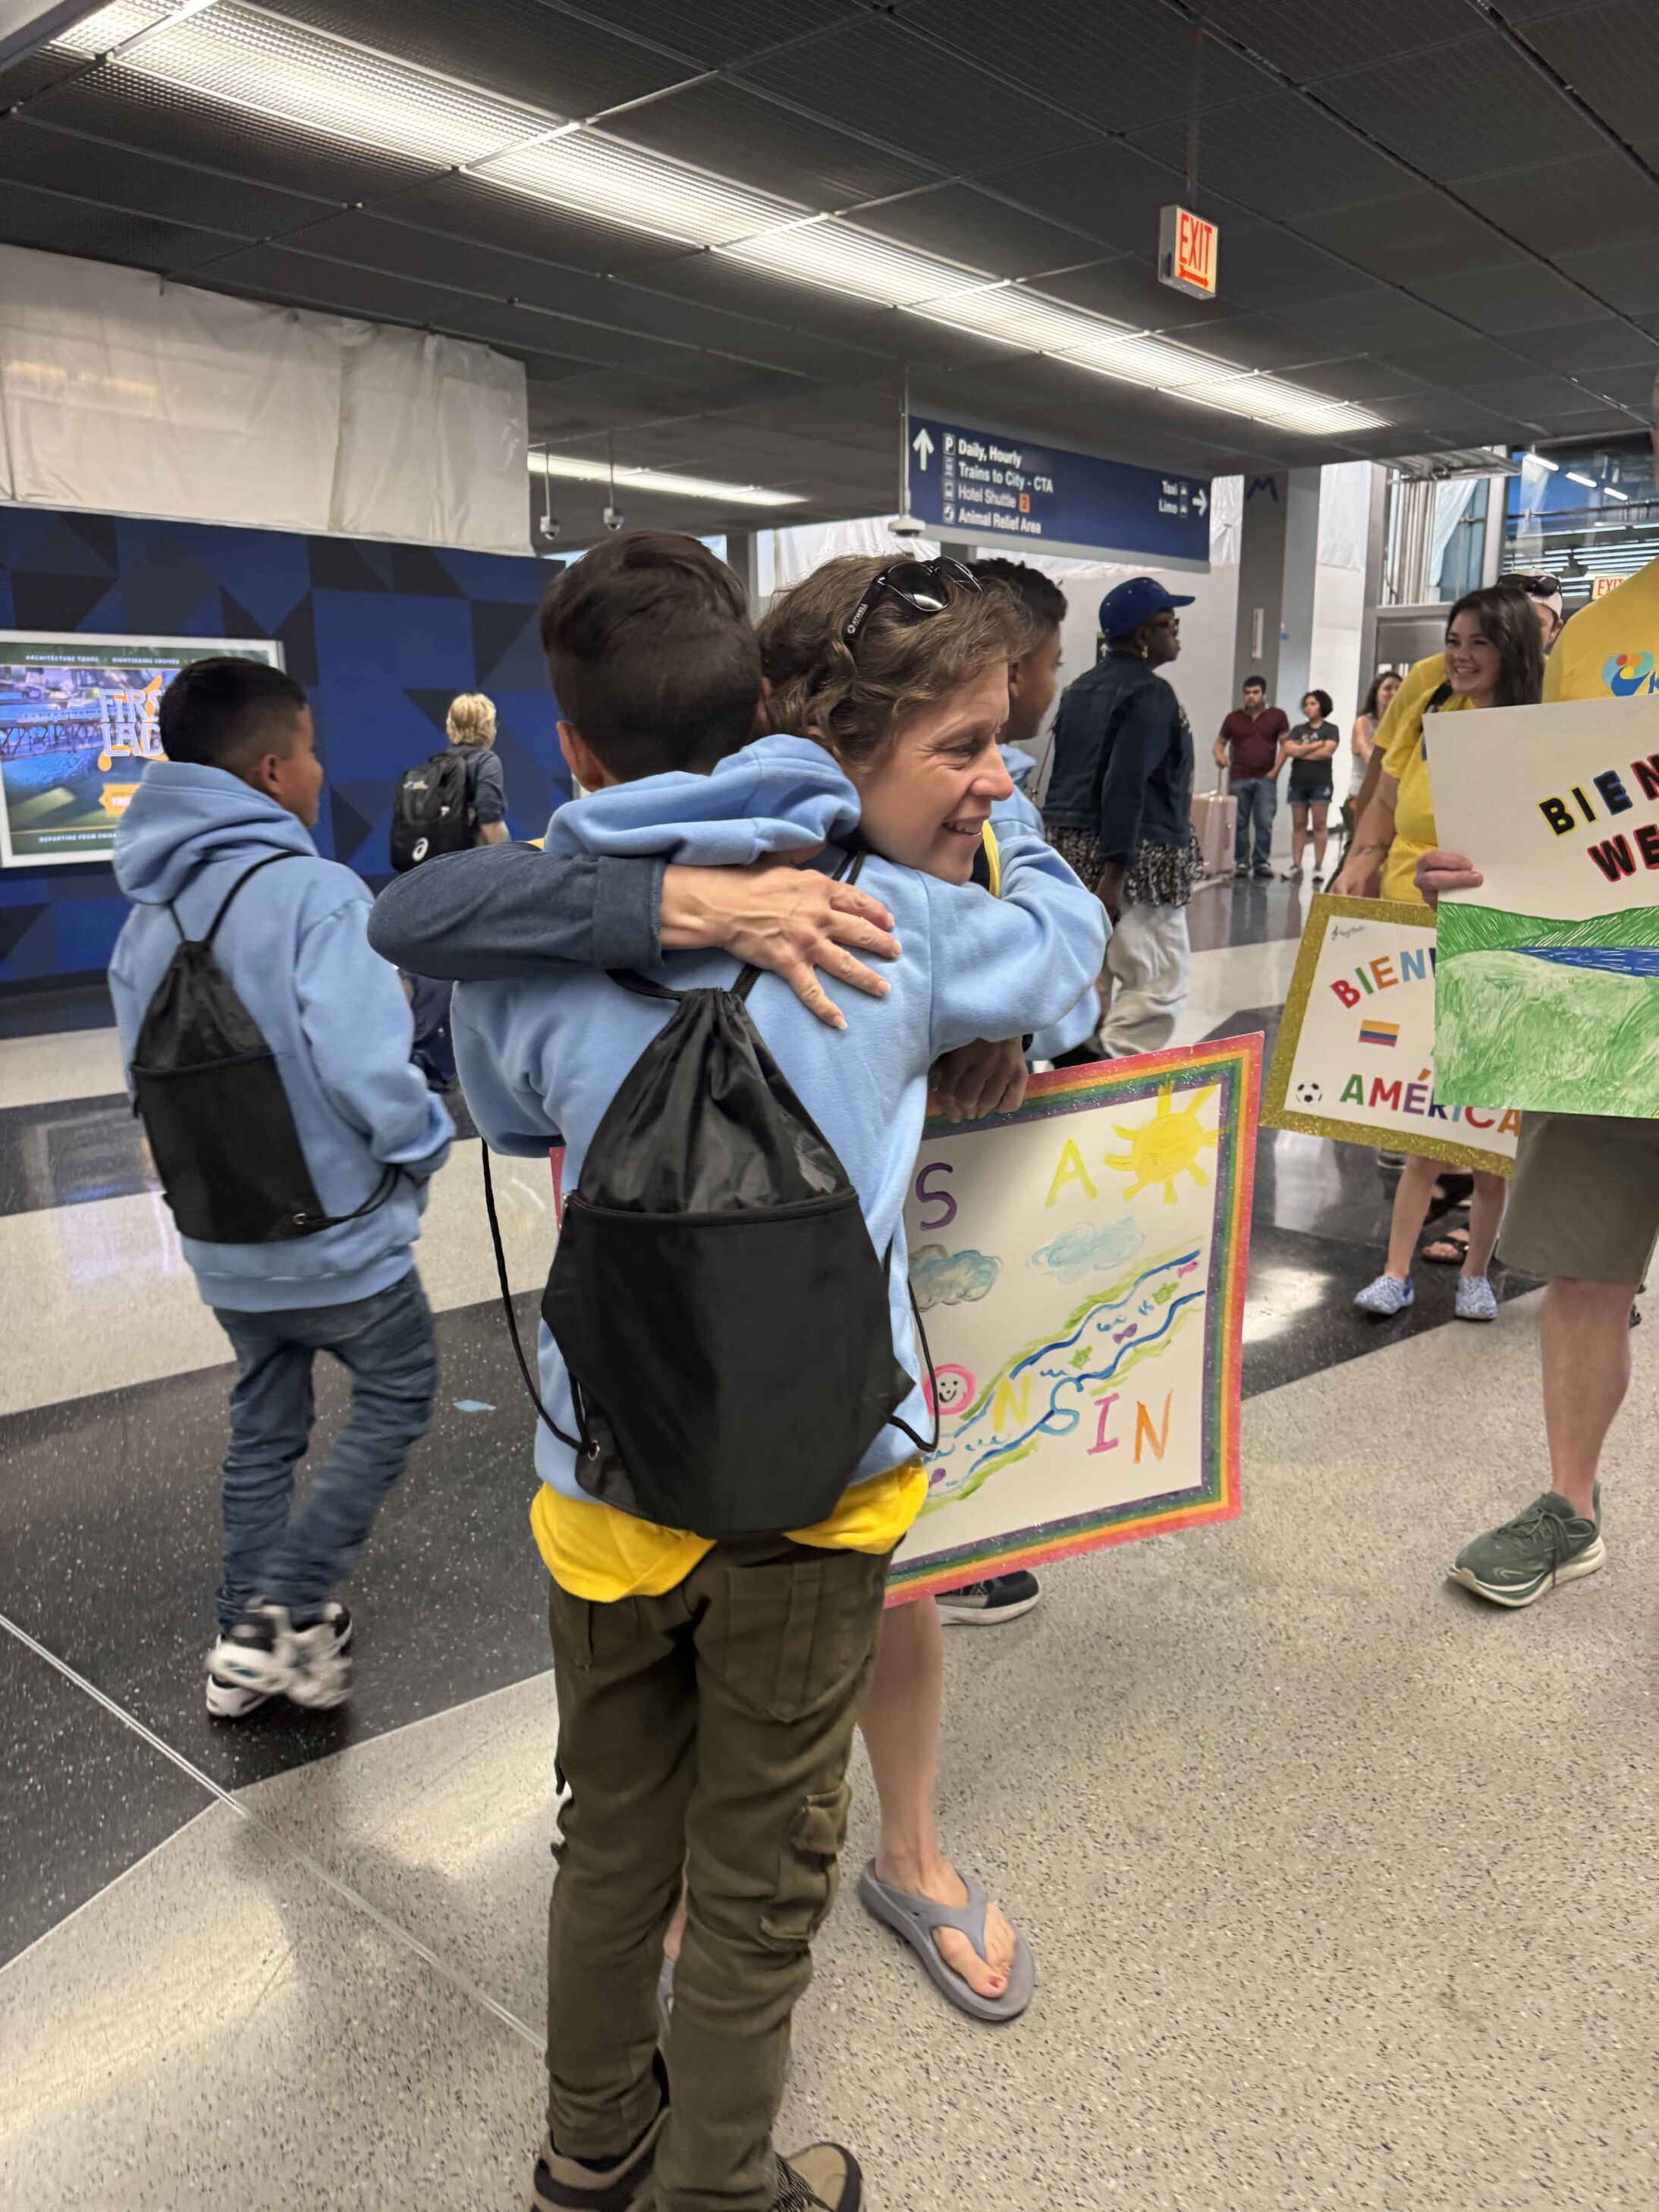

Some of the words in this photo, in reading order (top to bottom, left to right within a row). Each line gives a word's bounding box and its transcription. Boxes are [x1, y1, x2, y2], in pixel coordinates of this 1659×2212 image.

[1180, 212, 1212, 275] EXIT
[958, 438, 987, 461] Daily,
[989, 445, 1022, 469] Hourly
[958, 461, 990, 482] Trains
[992, 470, 1004, 485] to
[1005, 470, 1026, 491] City
[1033, 476, 1054, 494] CTA
[1161, 480, 1178, 496] Taxi
[958, 485, 984, 504] Hotel
[985, 488, 1016, 509] Shuttle
[1158, 498, 1178, 514] Limo
[958, 507, 992, 526] Animal
[993, 512, 1020, 531] Relief
[1020, 517, 1042, 534] Area
[1597, 579, 1623, 595] EXI
